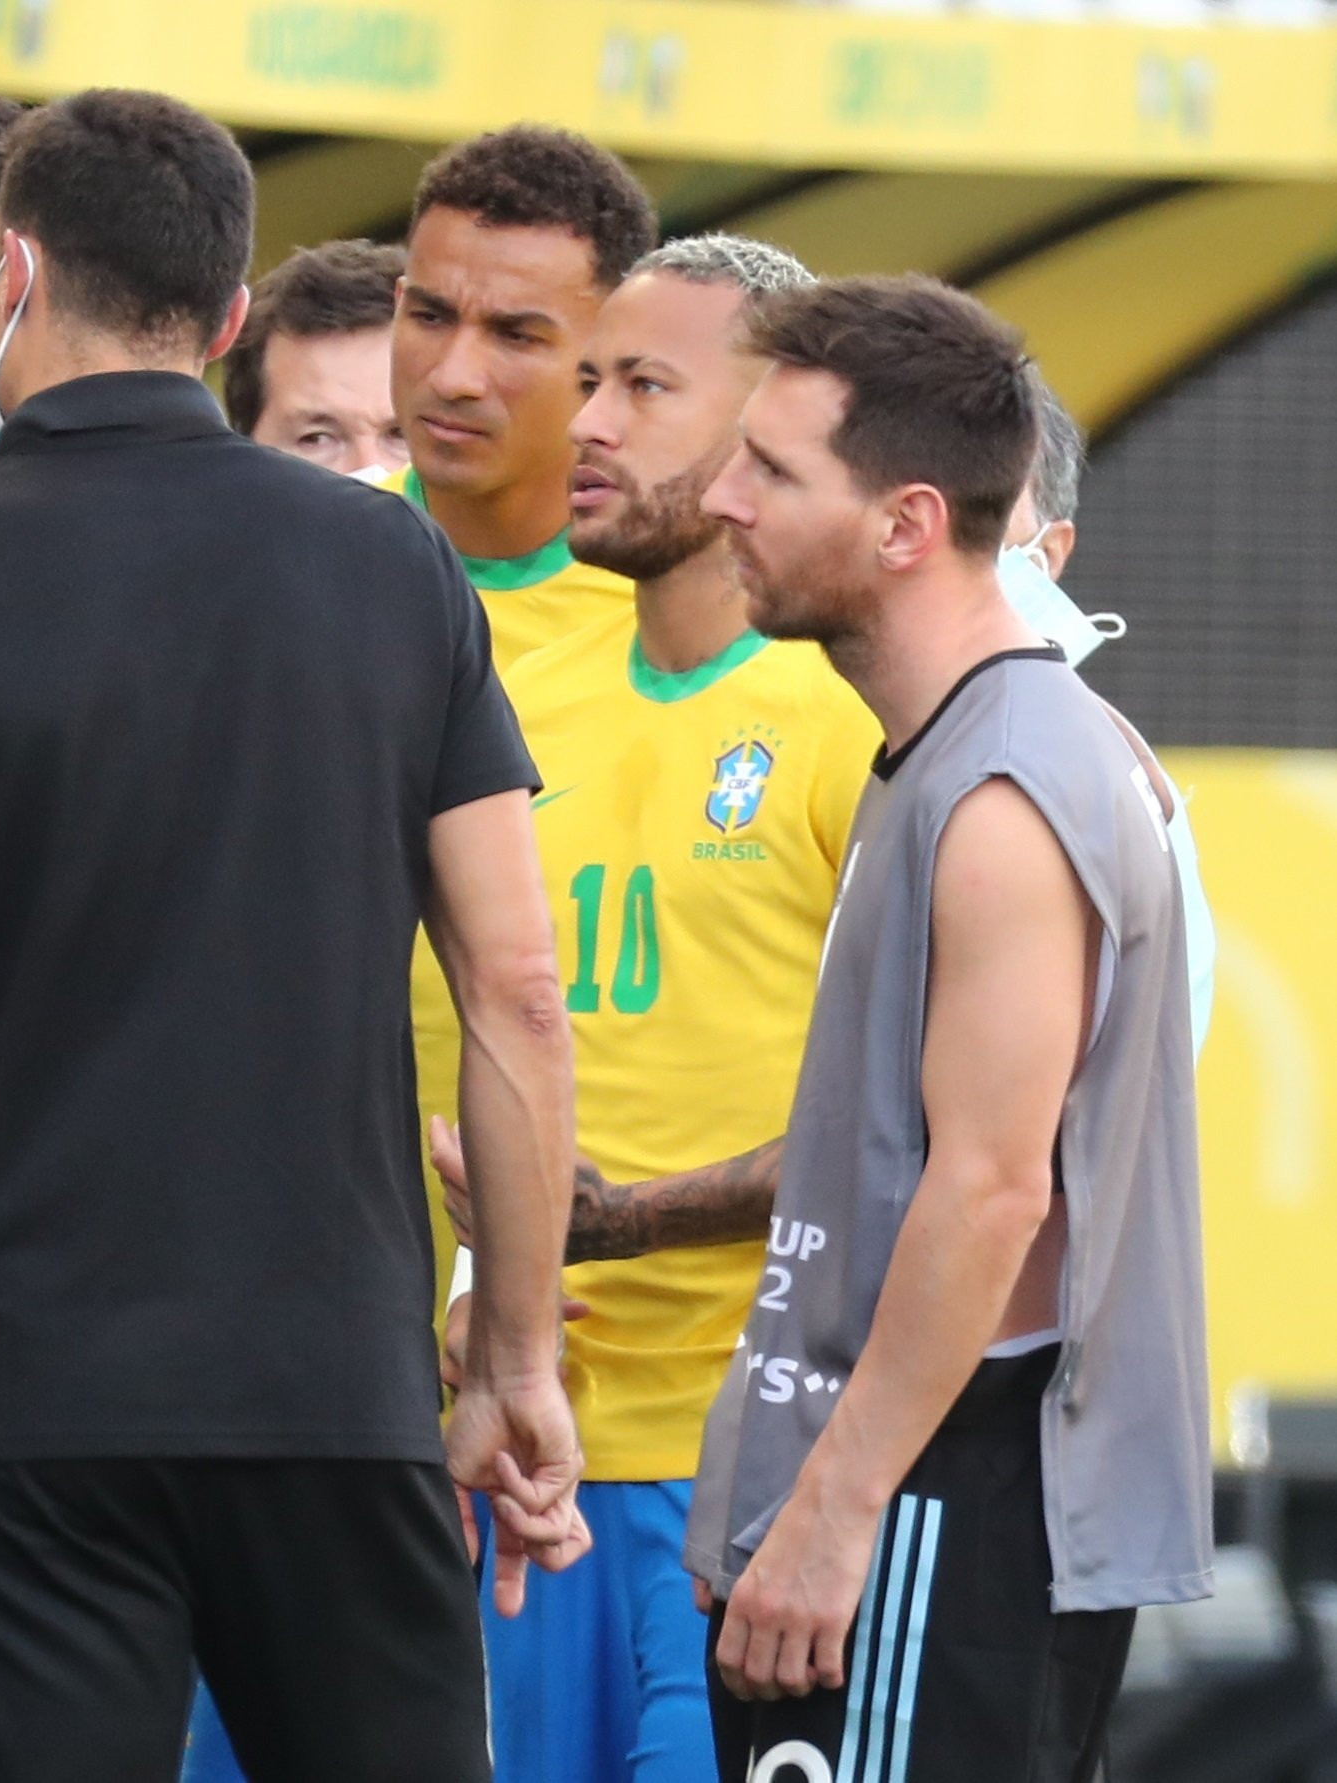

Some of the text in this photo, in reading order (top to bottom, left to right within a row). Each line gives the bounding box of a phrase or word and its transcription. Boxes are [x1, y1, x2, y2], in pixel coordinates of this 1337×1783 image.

[726, 777, 752, 790] CBF
[691, 842, 768, 861] BRASIL
[566, 864, 661, 1014] 10
[767, 1216, 826, 1261] UP
